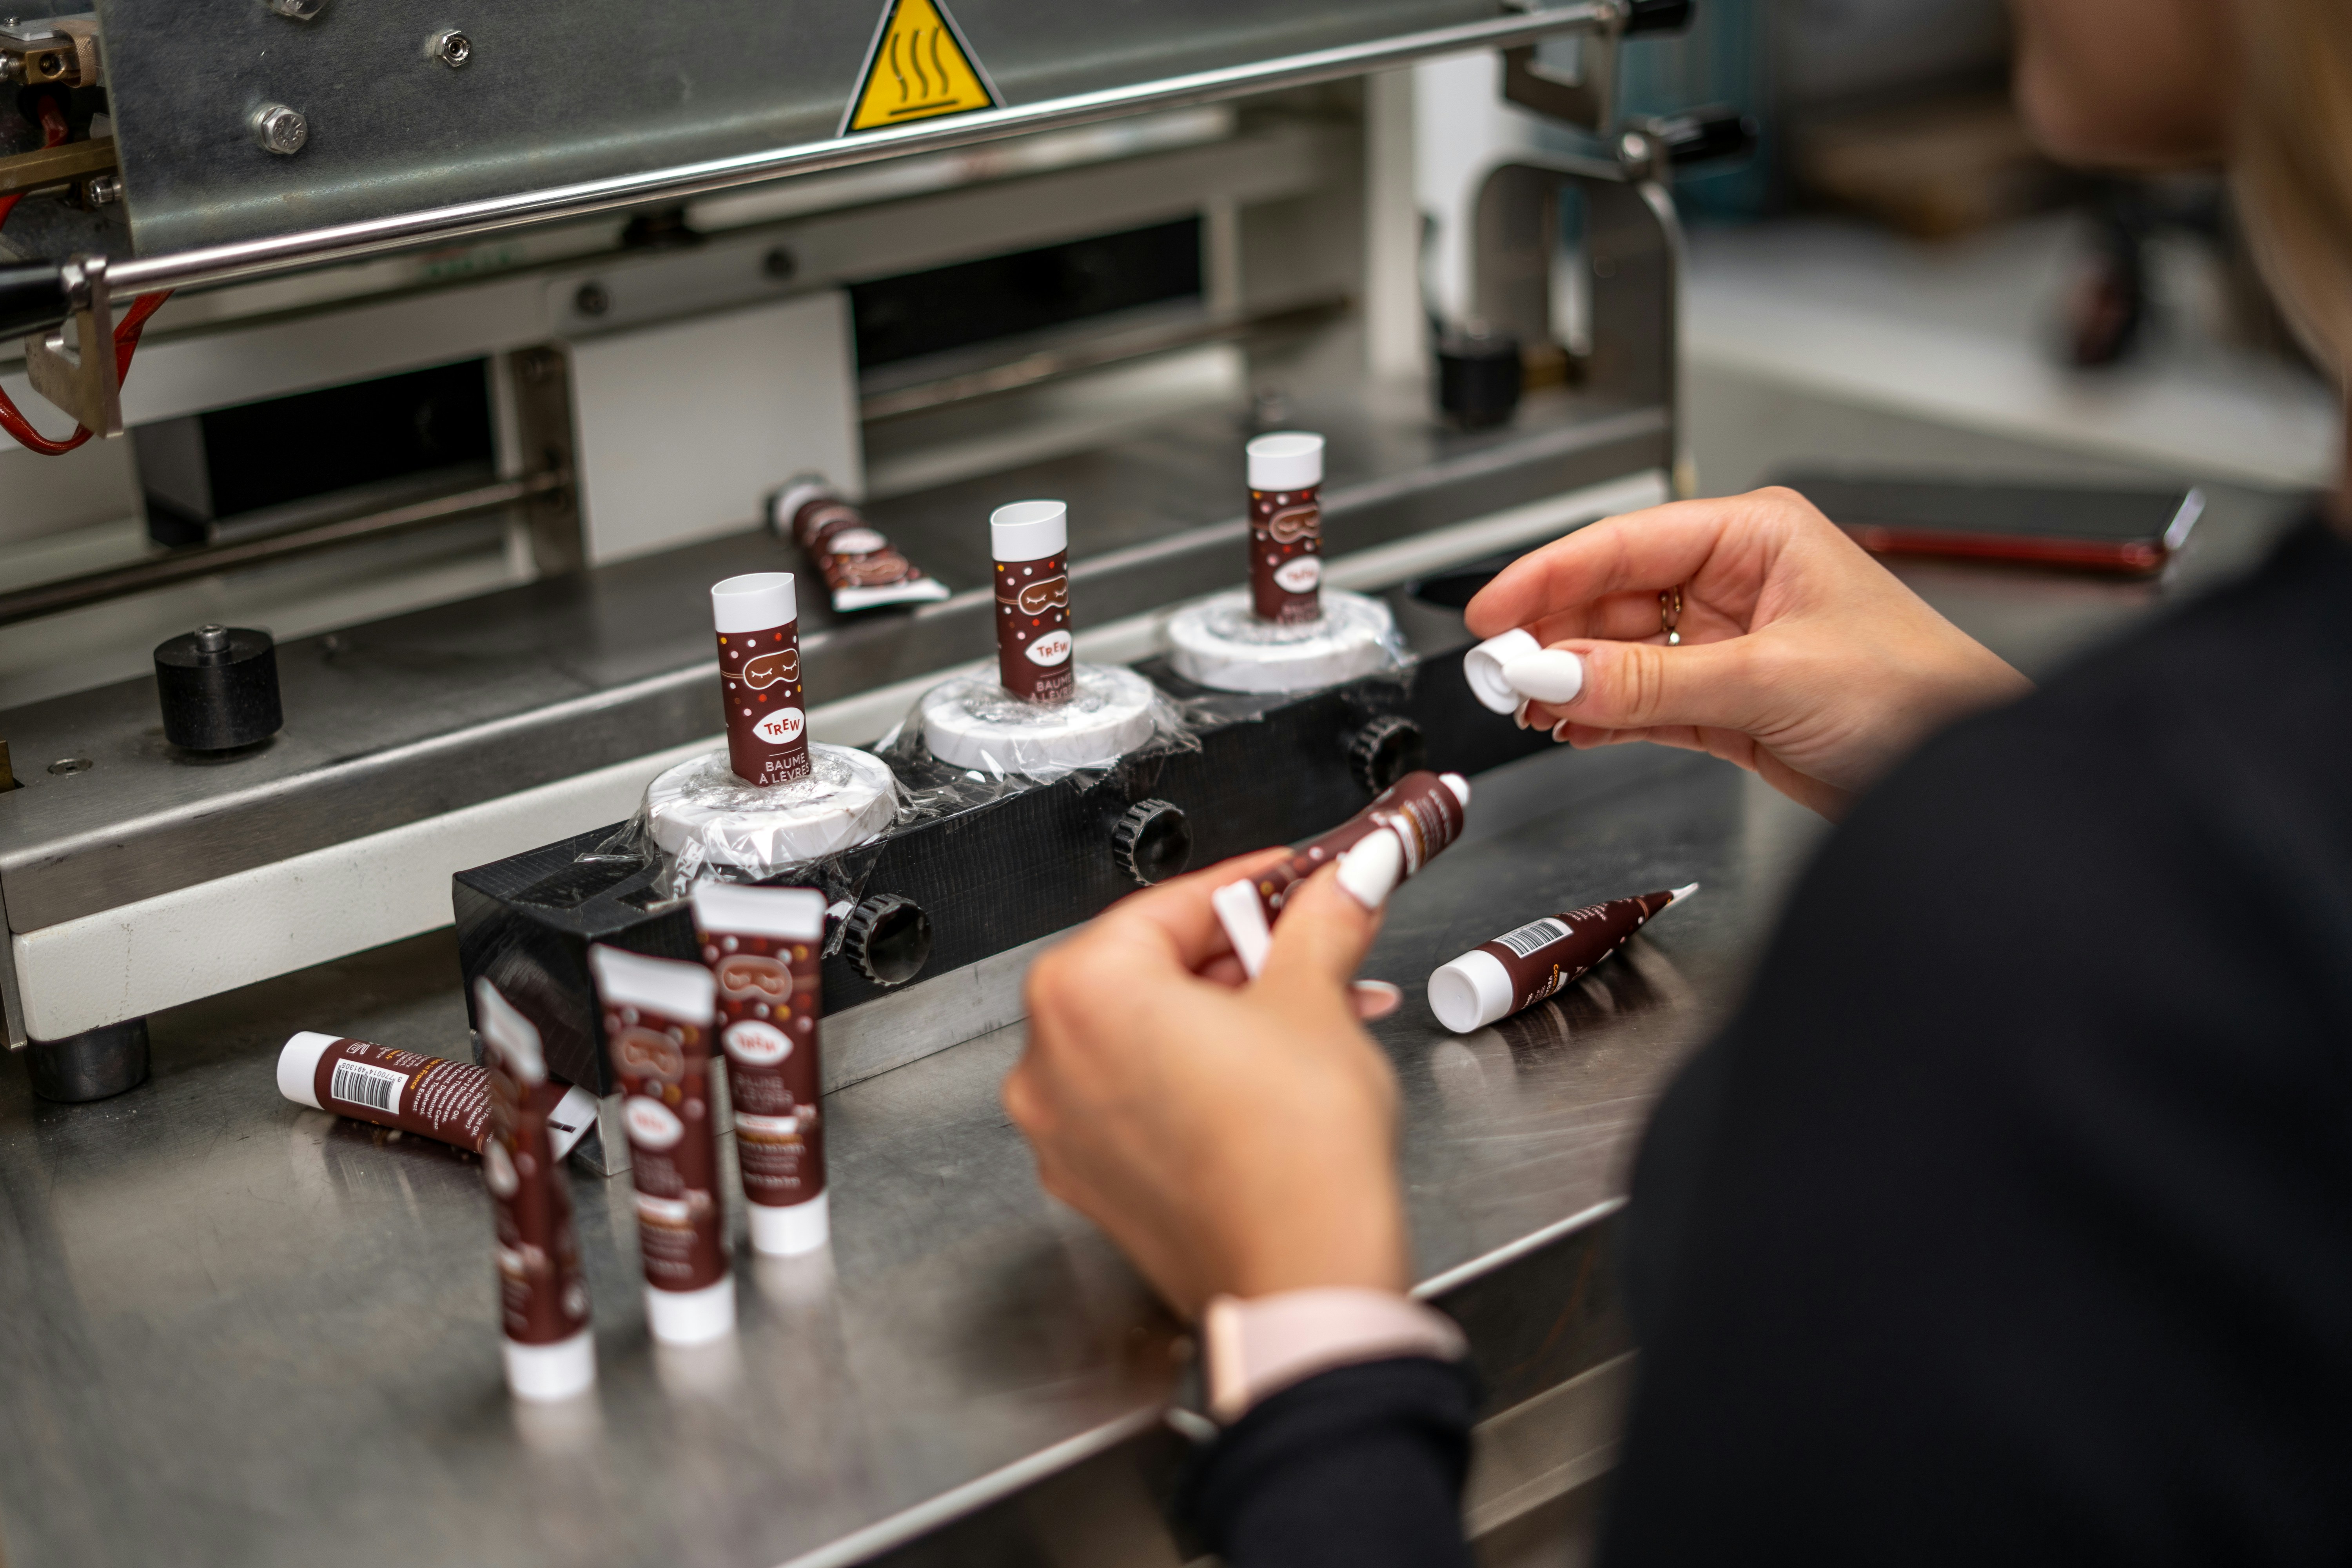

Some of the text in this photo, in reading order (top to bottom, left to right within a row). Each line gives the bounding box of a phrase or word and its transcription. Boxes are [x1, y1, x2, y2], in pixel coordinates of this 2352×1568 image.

[1037, 641, 1068, 657] TREW
[1036, 673, 1071, 691] BAUME
[764, 719, 800, 735] TREW
[766, 753, 805, 771] BAUME
[759, 762, 809, 784] À LÈVRES
[342, 1063, 367, 1073] 491305
[369, 1069, 394, 1080] 770014
[421, 1062, 447, 1087] Rebaudiana
[410, 1069, 428, 1089] France
[412, 1089, 425, 1111] Extract
[427, 1085, 446, 1118] Dipalmitoyl
[438, 1081, 462, 1109] Theobroma
[457, 1093, 472, 1109] Castor
[465, 1106, 483, 1129] (Castor)
[476, 1112, 489, 1125] Fruit
